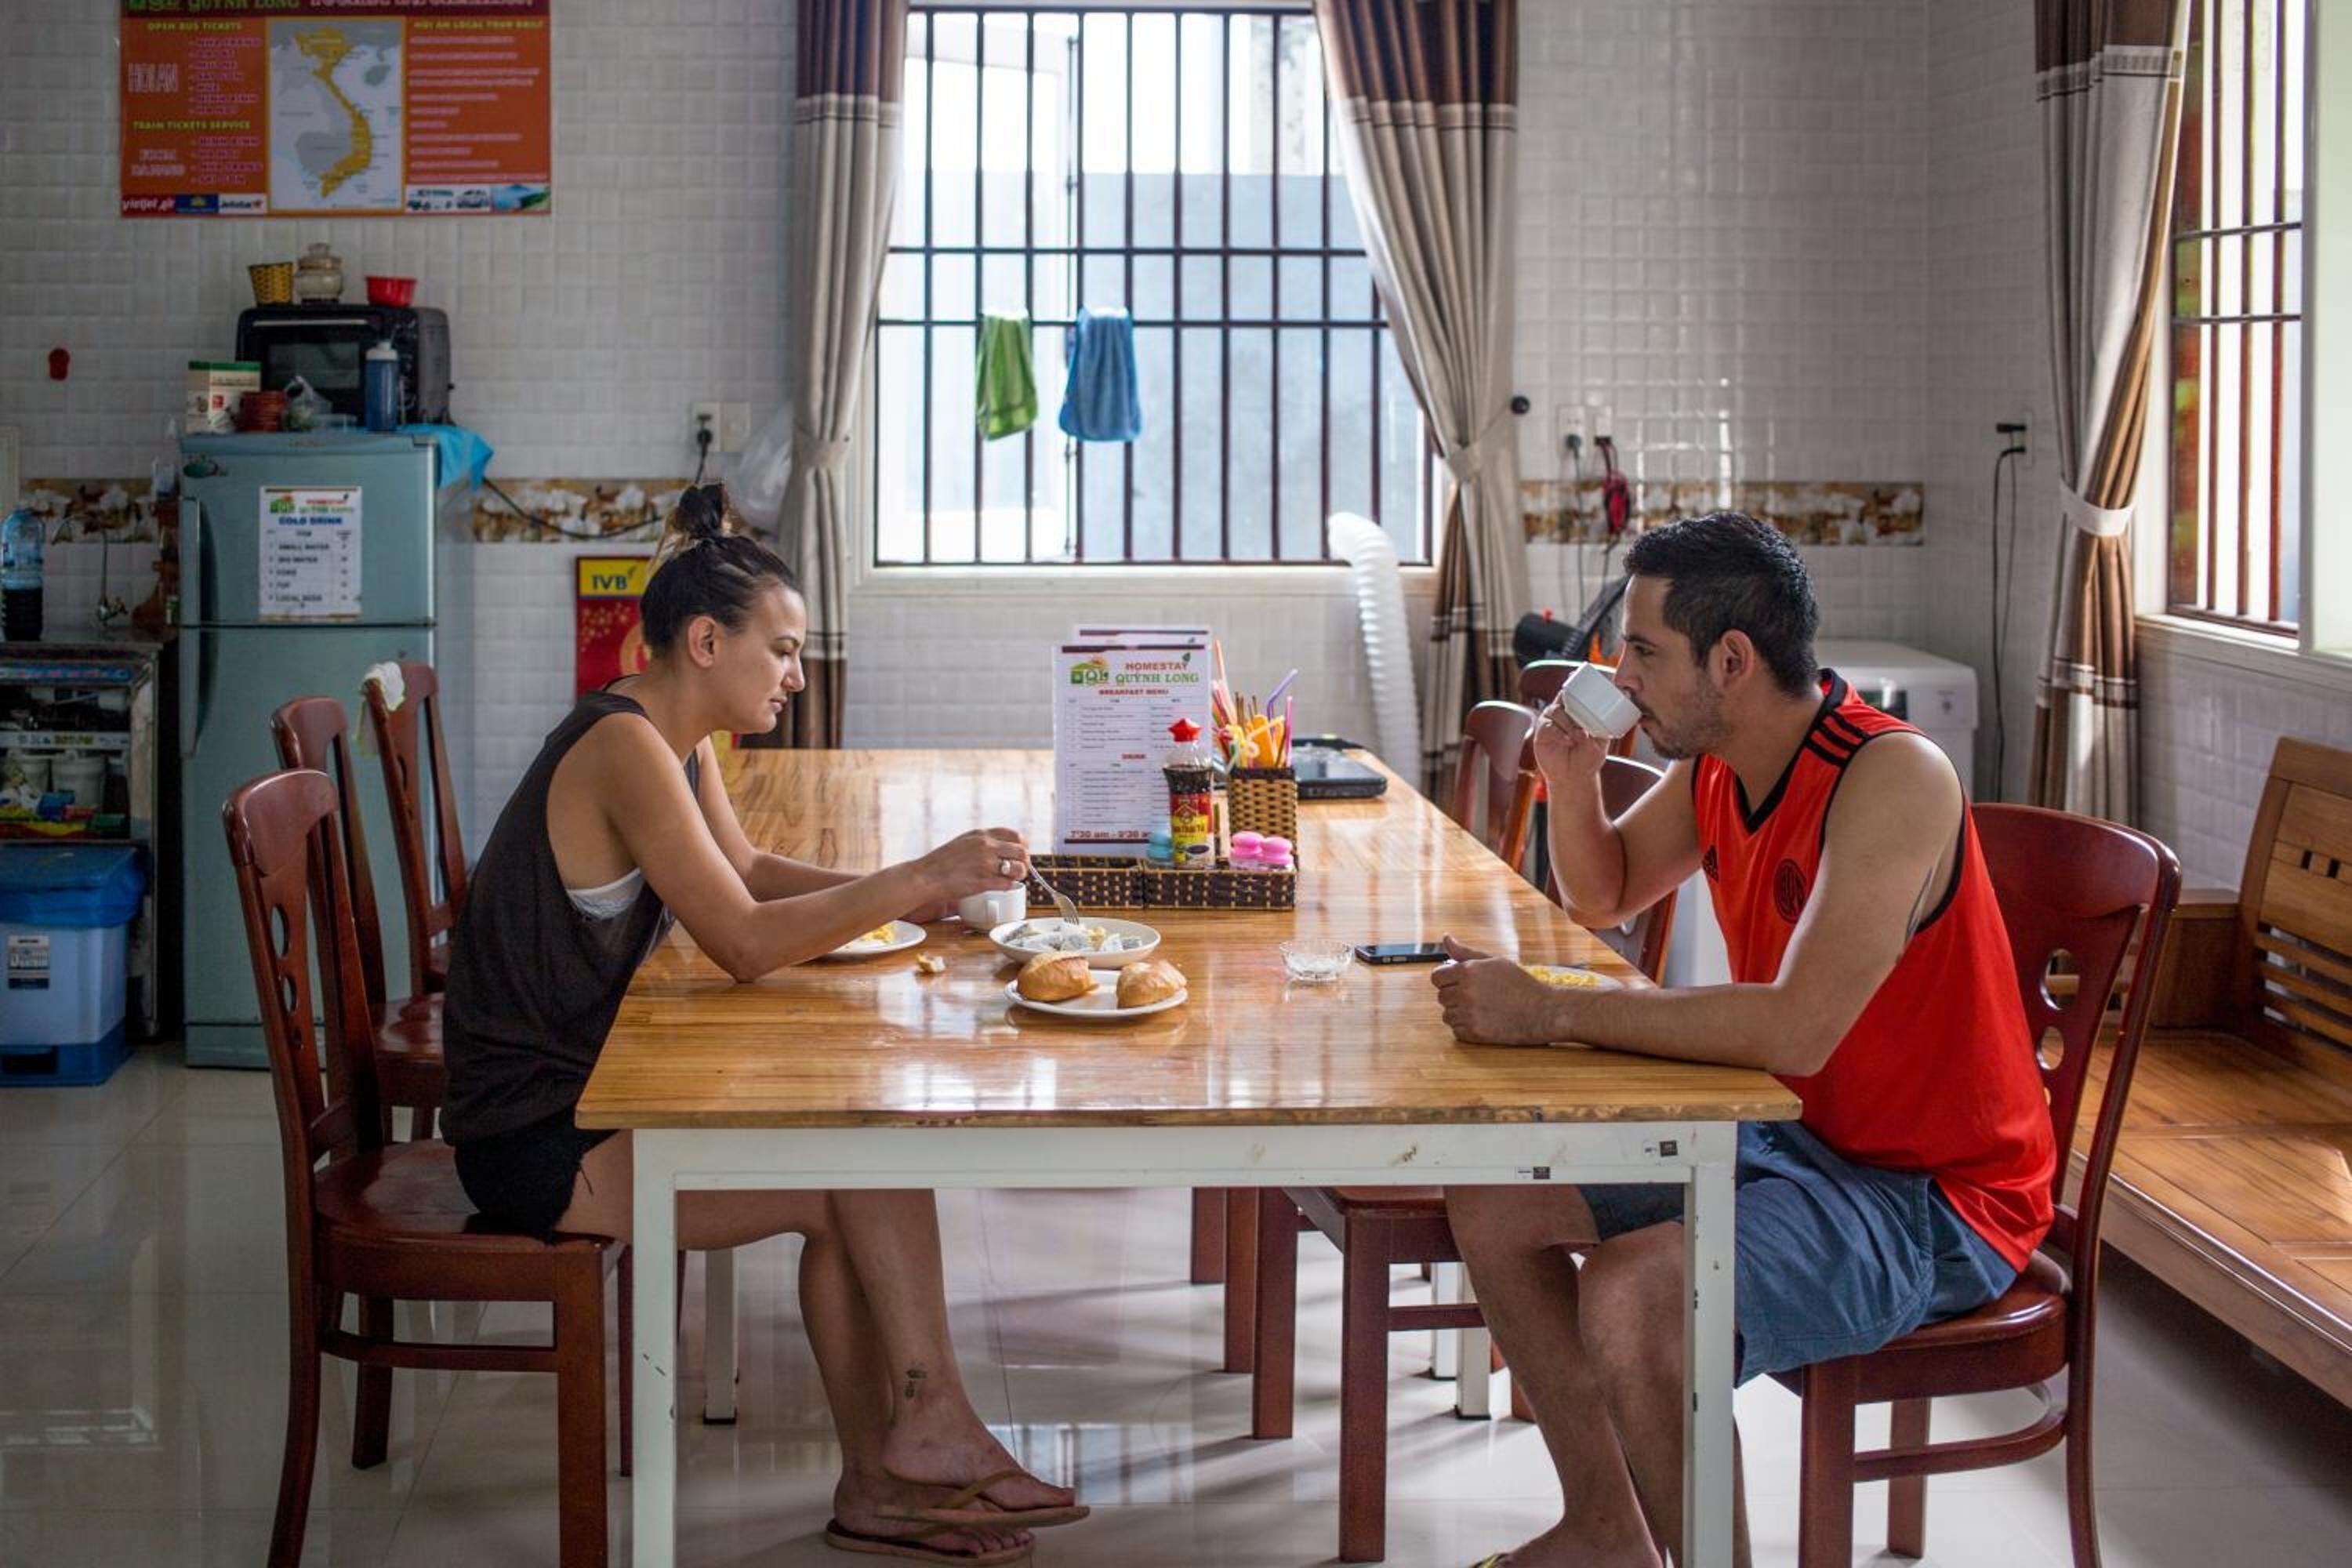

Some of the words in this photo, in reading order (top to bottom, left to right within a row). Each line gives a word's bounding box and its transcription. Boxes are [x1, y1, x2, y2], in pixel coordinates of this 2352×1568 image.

[133, 121, 165, 130] TRAIN
[167, 121, 207, 130] TICKETS
[210, 121, 251, 130] SERVICE
[278, 517, 307, 525] COLD
[310, 517, 343, 525] DRINK
[592, 575, 628, 590] IVB
[1125, 662, 1189, 670] HOMESTAY
[1164, 673, 1200, 683] LONG
